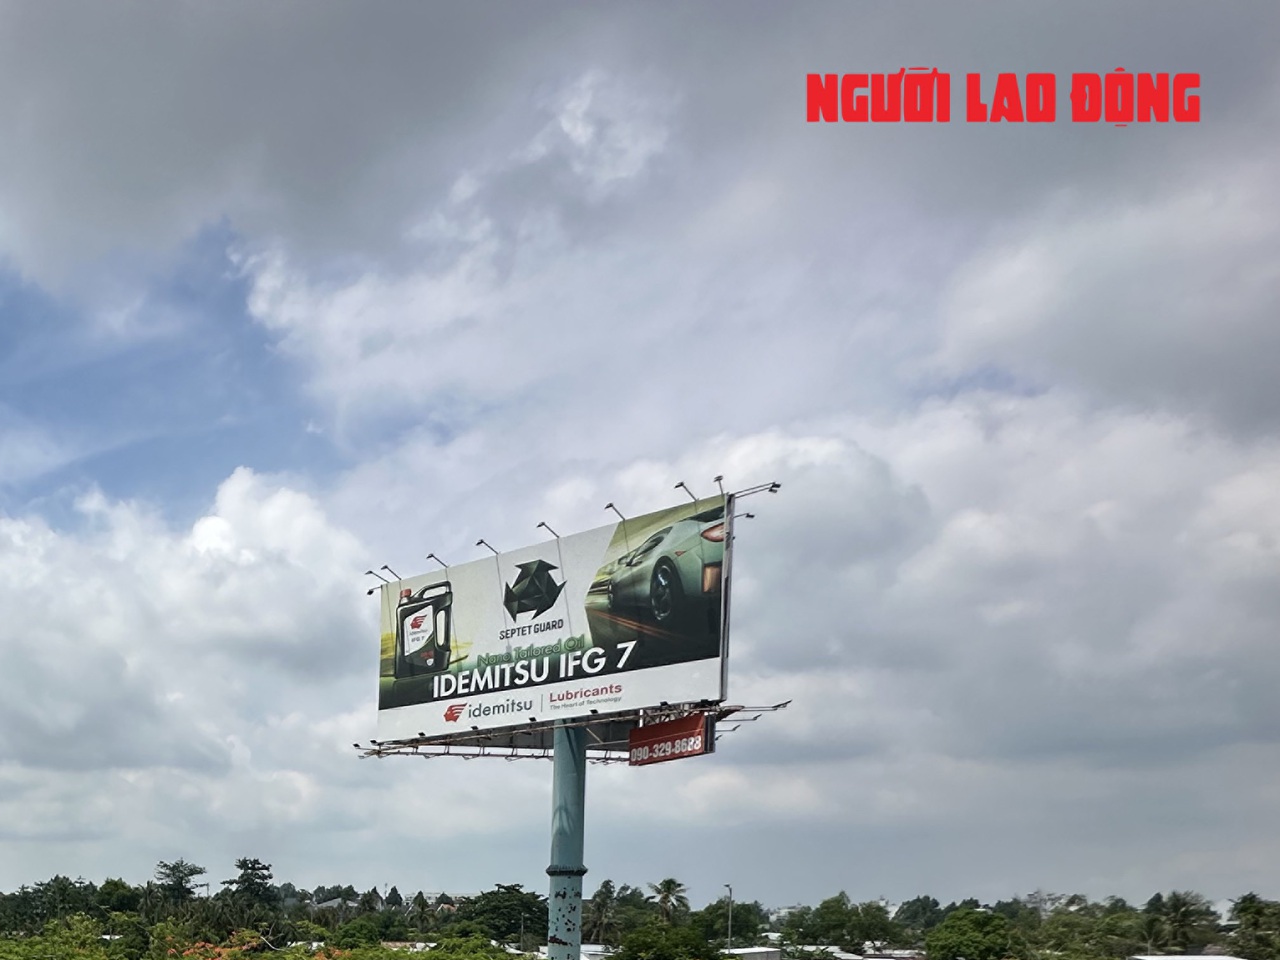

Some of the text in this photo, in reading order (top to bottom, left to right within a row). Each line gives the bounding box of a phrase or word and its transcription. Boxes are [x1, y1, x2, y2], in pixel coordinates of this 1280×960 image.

[499, 618, 565, 640] SEPTET GUARD
[476, 633, 586, 668] Nano Tailored Oil
[433, 640, 638, 699] IDEMITSU IFG 7
[549, 684, 622, 703] Lubricants
[550, 703, 561, 711] The
[561, 701, 578, 709] Heart
[586, 695, 622, 706] Technology
[468, 698, 533, 719] idemitsu
